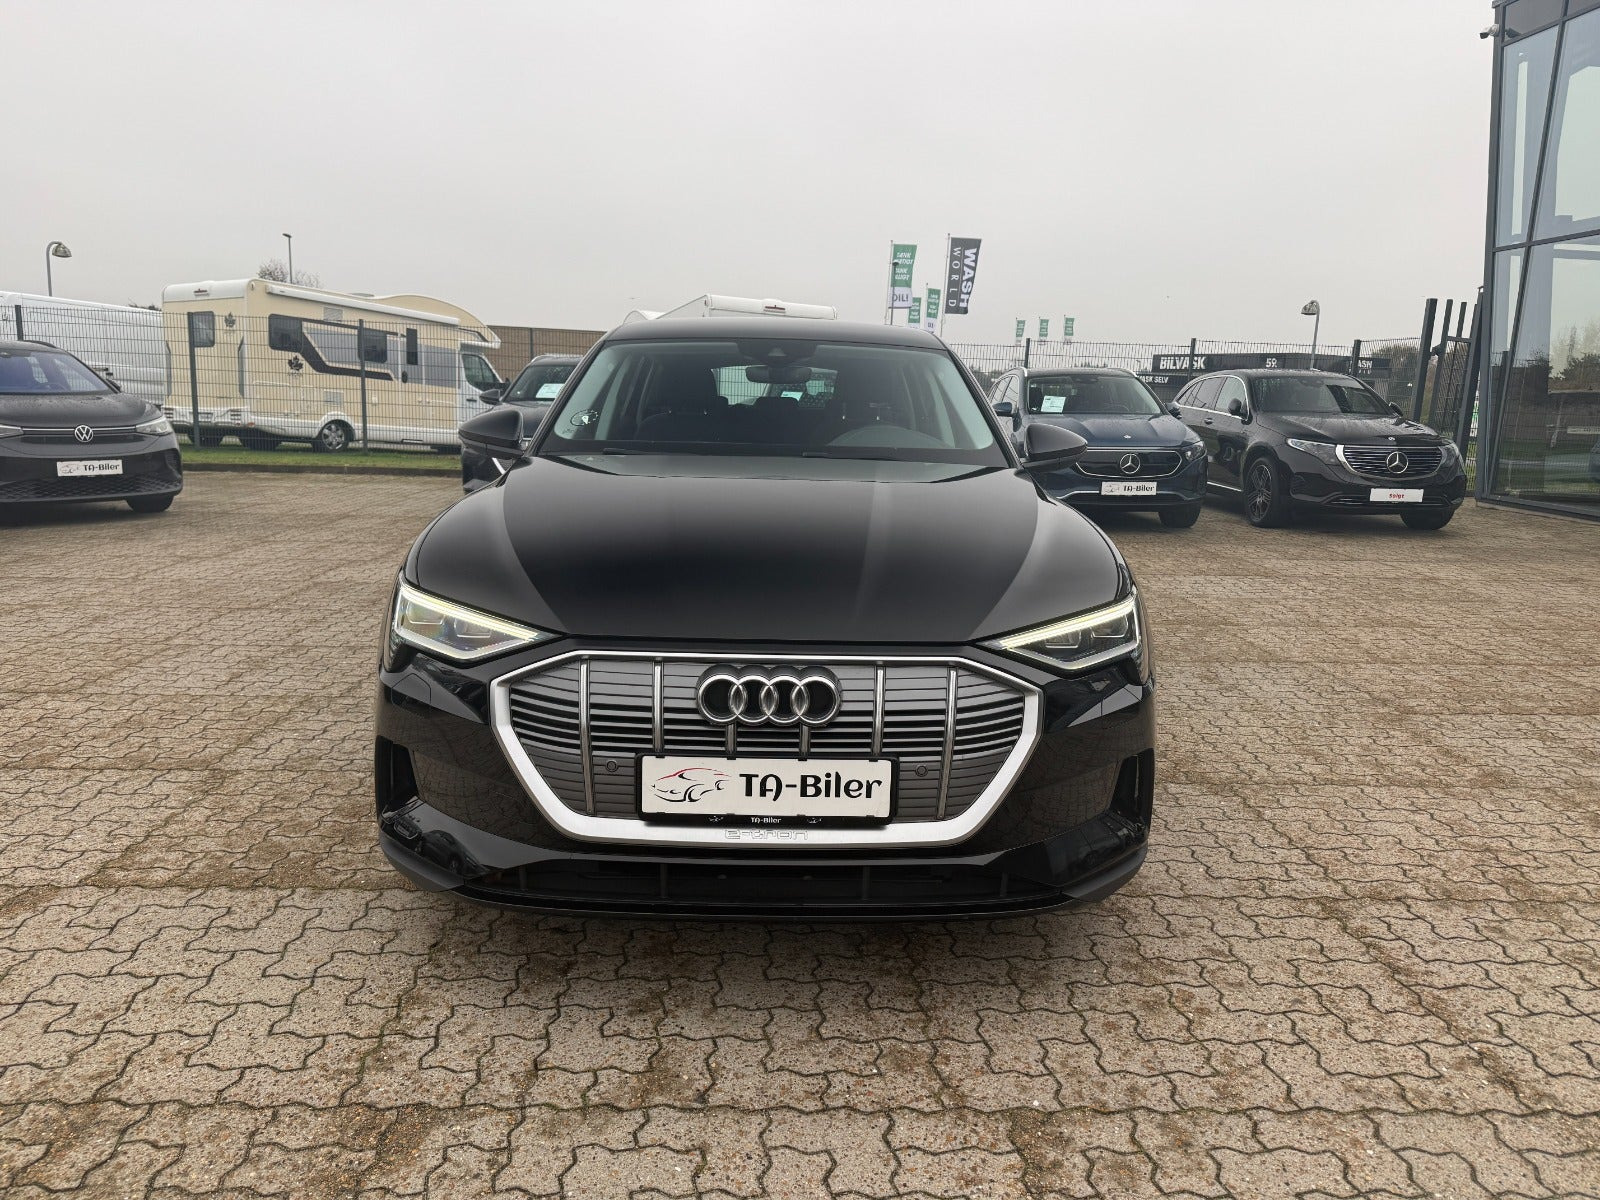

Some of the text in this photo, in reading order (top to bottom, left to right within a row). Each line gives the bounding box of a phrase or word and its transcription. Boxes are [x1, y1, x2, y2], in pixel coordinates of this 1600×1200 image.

[948, 247, 962, 307] WORLD
[960, 248, 978, 307] WASH
[1160, 356, 1207, 370] BILVASK
[83, 463, 120, 472] TA-Biler
[1123, 484, 1155, 492] TA-Biler
[739, 771, 883, 802] TA-Biler
[724, 829, 809, 841] e-tron
